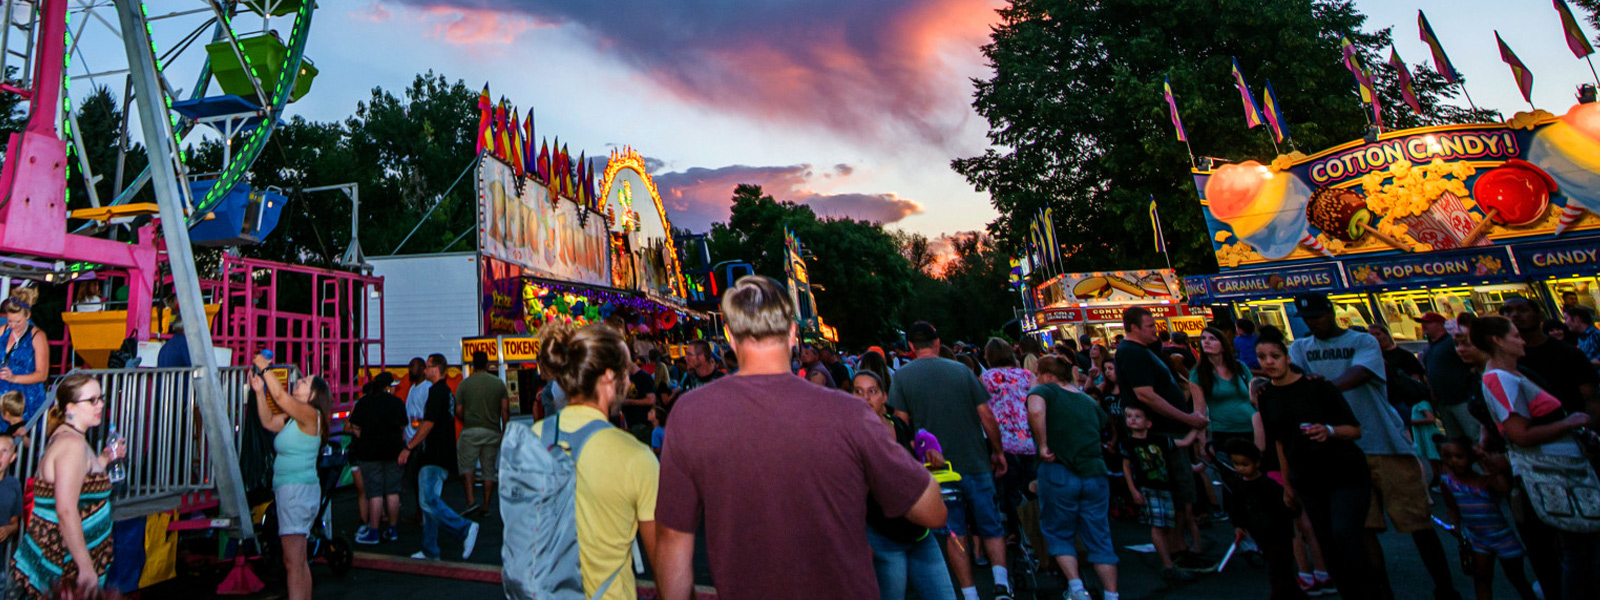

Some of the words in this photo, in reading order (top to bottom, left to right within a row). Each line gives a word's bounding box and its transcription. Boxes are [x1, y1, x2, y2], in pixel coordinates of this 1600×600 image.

[1311, 141, 1404, 183] COTTON
[1407, 133, 1499, 160] CANDY
[1532, 248, 1597, 267] CANDY
[1382, 265, 1414, 279] POP
[1422, 261, 1469, 275] CORN
[1217, 279, 1270, 293] CARAMEL
[1285, 272, 1331, 287] APPLES
[1172, 320, 1204, 333] TOKENS
[464, 342, 497, 357] TOKENS
[504, 340, 540, 355] TOKENS
